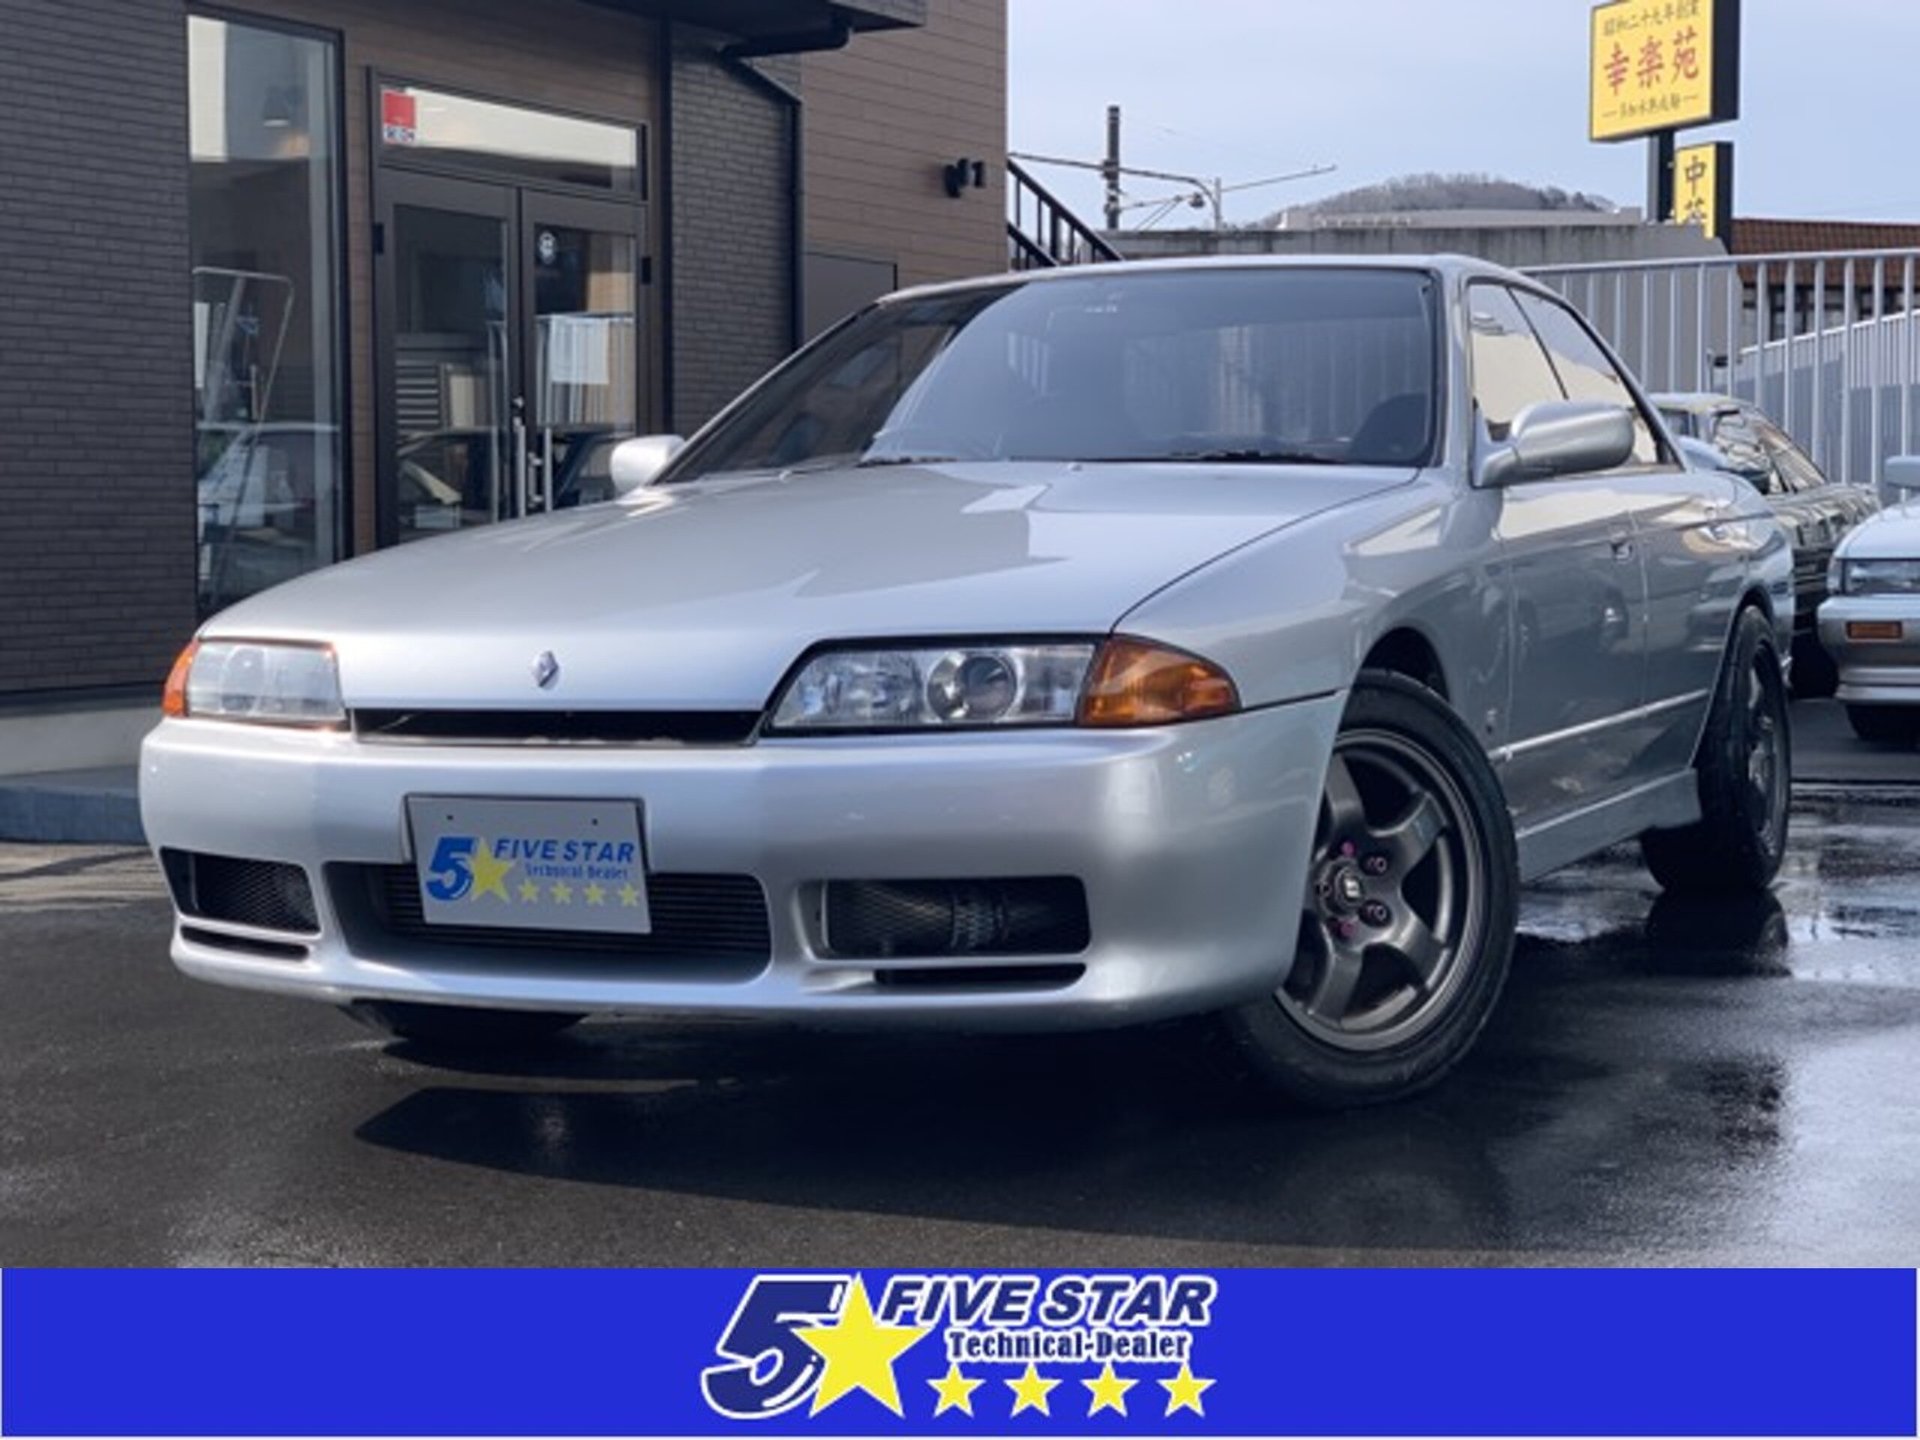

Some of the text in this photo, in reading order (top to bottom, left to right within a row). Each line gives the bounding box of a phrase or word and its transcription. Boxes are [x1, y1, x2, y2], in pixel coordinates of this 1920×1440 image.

[1603, 25, 1698, 96] 幸楽苑
[425, 836, 635, 901] 5 FIVE STAR
